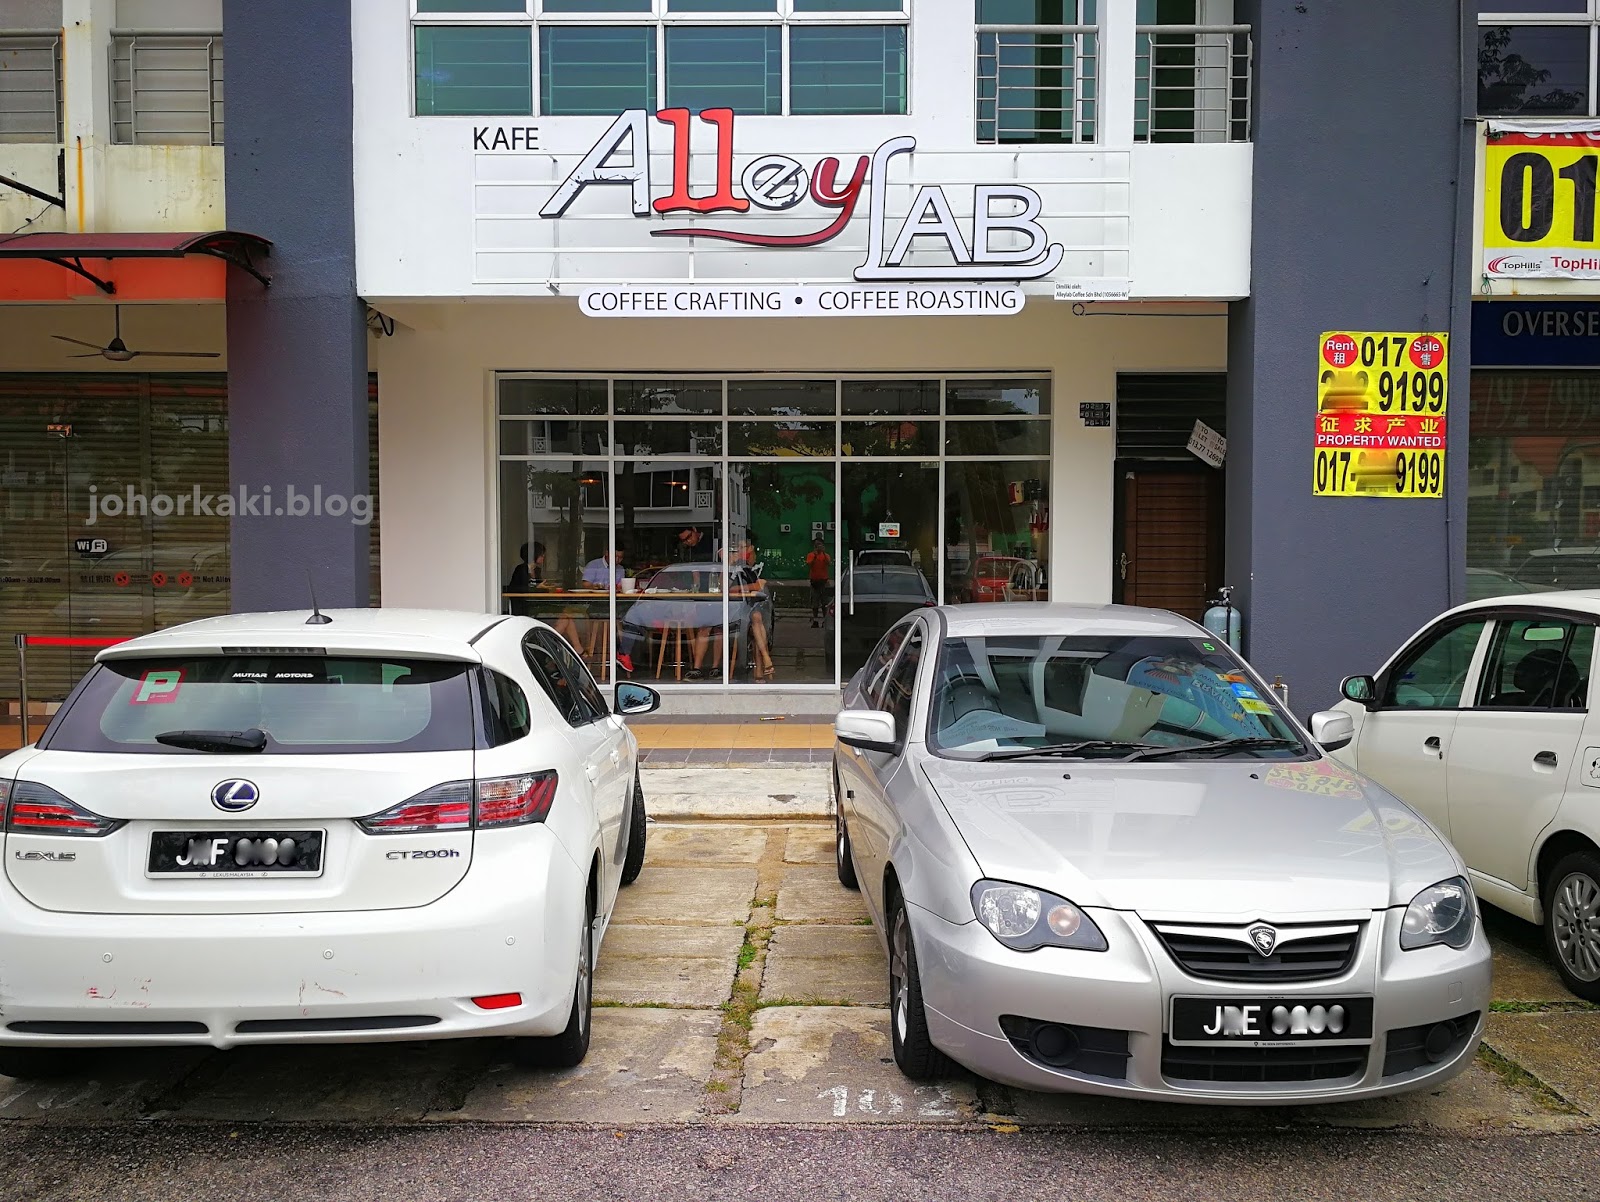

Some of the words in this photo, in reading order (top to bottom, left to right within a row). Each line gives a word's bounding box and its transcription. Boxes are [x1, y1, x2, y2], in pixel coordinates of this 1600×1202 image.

[473, 126, 540, 150] KAFE
[1502, 262, 1541, 271] TopHills
[587, 292, 668, 311] COFFEE
[674, 292, 782, 311] CRAFTING
[818, 291, 900, 311] COFFEE
[906, 290, 1017, 310] ROASTING
[1056, 291, 1073, 299] Alleylab
[1326, 340, 1355, 351] Rent
[1361, 336, 1408, 367] 017
[1413, 341, 1440, 352] Sale
[1333, 352, 1346, 365] 租
[1378, 370, 1444, 412] 9199
[1317, 434, 1385, 446] PROPERTY
[1387, 436, 1441, 447] WANTED
[202, 575, 214, 583] Not
[136, 671, 181, 701] P
[16, 850, 76, 861] LEXUS
[175, 838, 229, 866] JF
[386, 849, 460, 860] CT200h
[1203, 1005, 1261, 1036] JE
